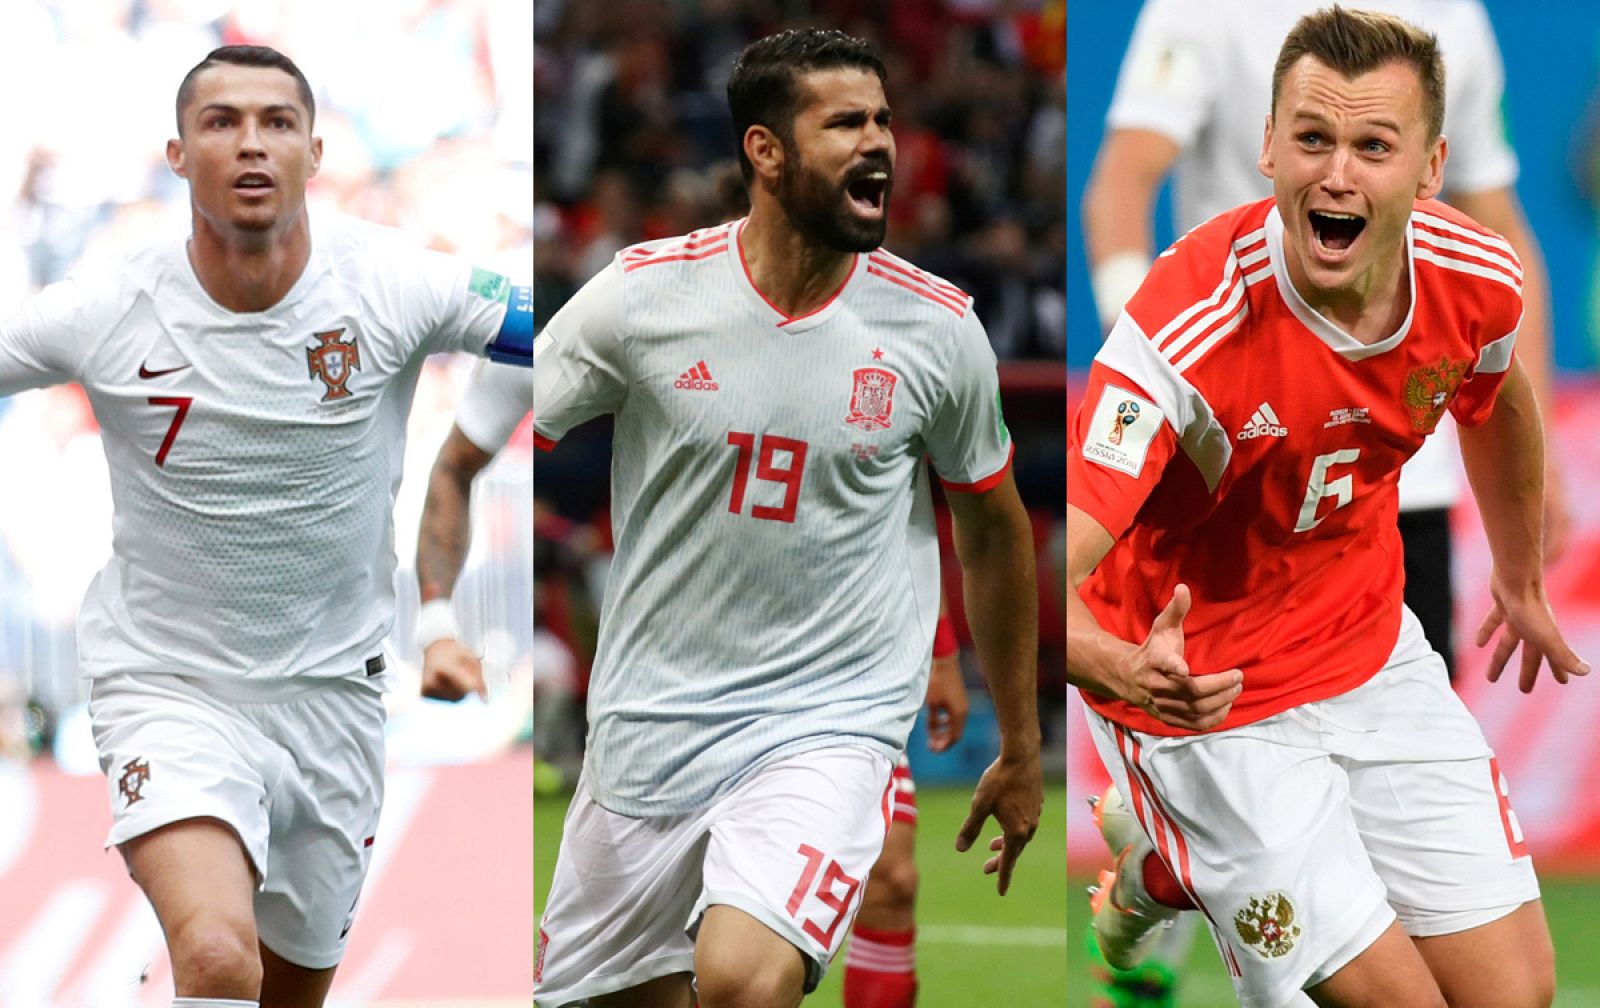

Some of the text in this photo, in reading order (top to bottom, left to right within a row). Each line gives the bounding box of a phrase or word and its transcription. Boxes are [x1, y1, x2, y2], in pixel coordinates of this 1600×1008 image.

[674, 378, 719, 391] adidas
[147, 397, 193, 468] 7
[1237, 423, 1288, 440] adidas
[727, 431, 808, 523] 19
[1293, 448, 1360, 533] 6
[785, 843, 860, 951] 19
